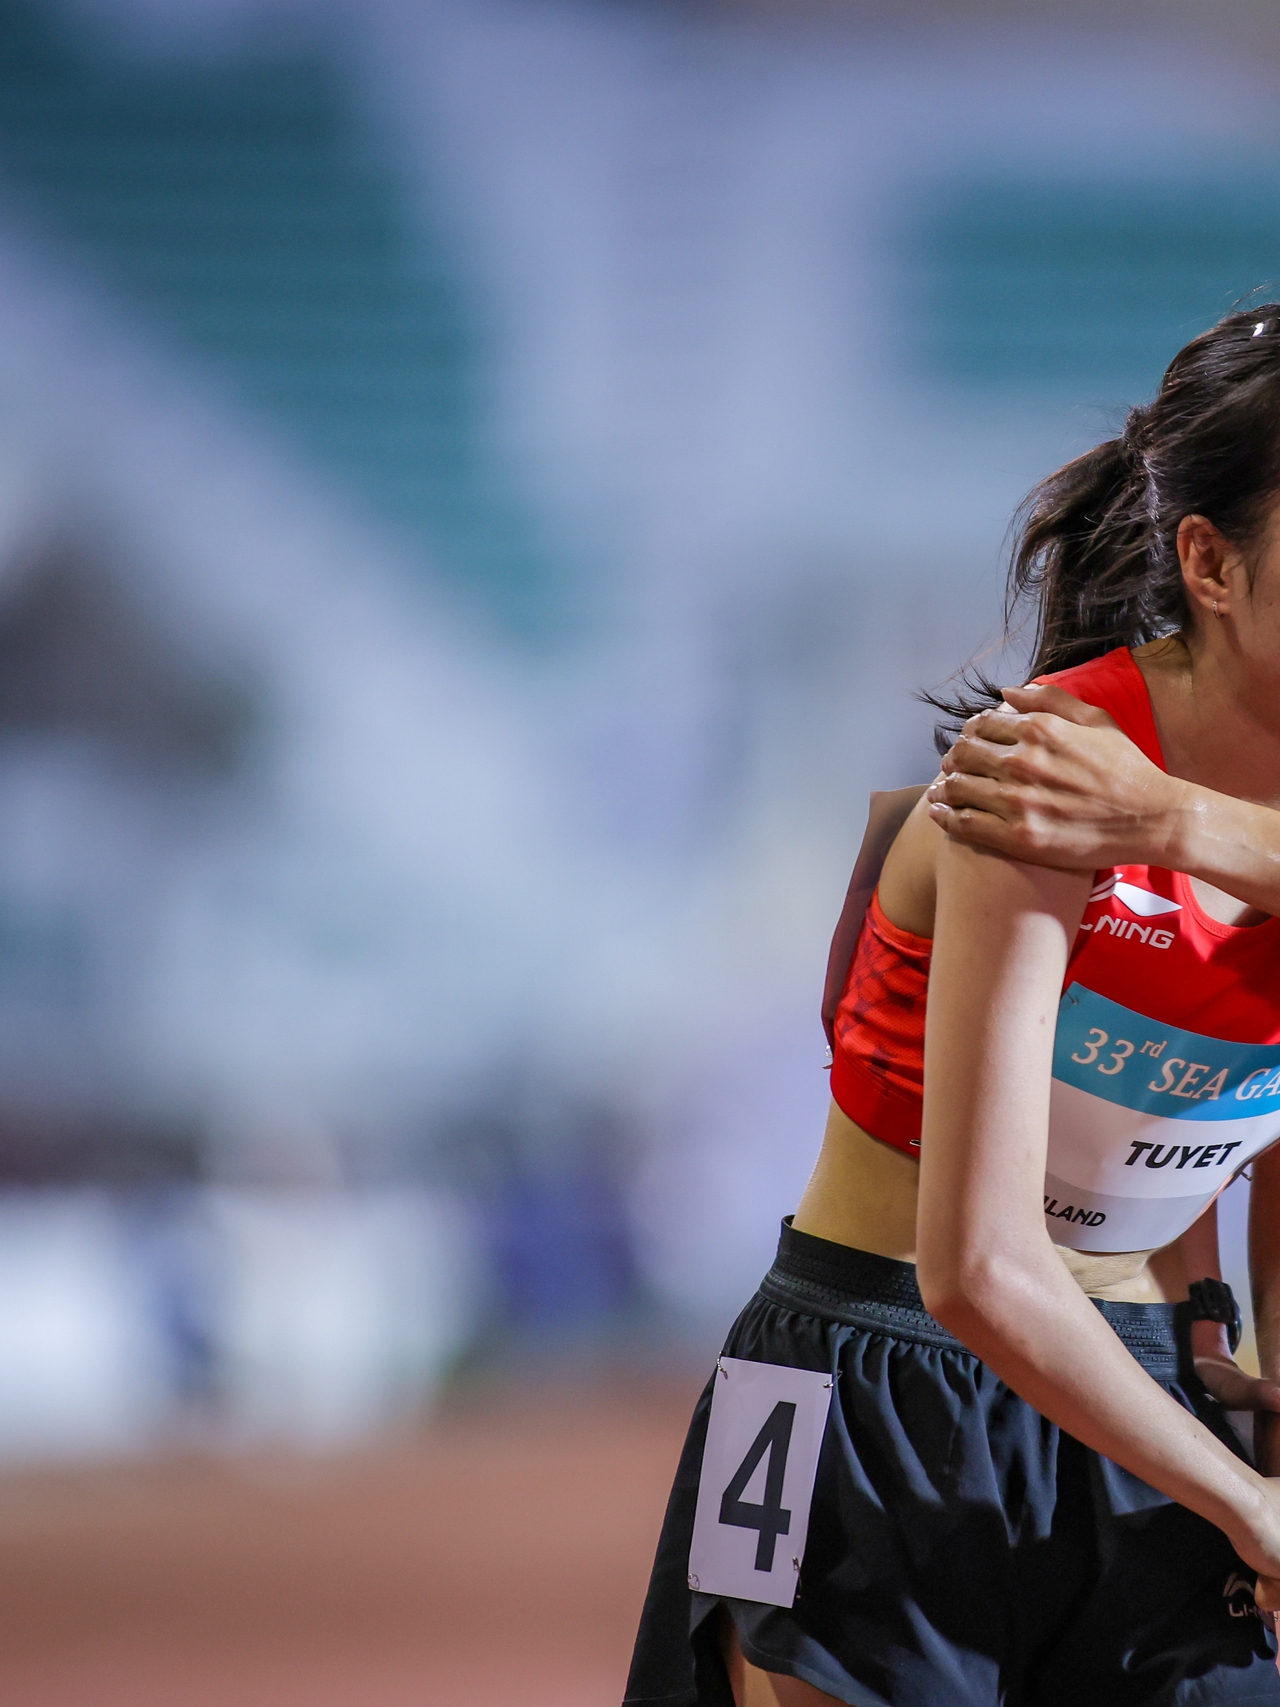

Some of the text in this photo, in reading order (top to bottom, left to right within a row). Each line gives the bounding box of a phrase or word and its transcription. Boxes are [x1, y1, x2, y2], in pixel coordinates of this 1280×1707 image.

[1148, 1057, 1230, 1101] SEA
[1124, 1140, 1243, 1170] TUYET
[718, 1400, 797, 1573] 4
